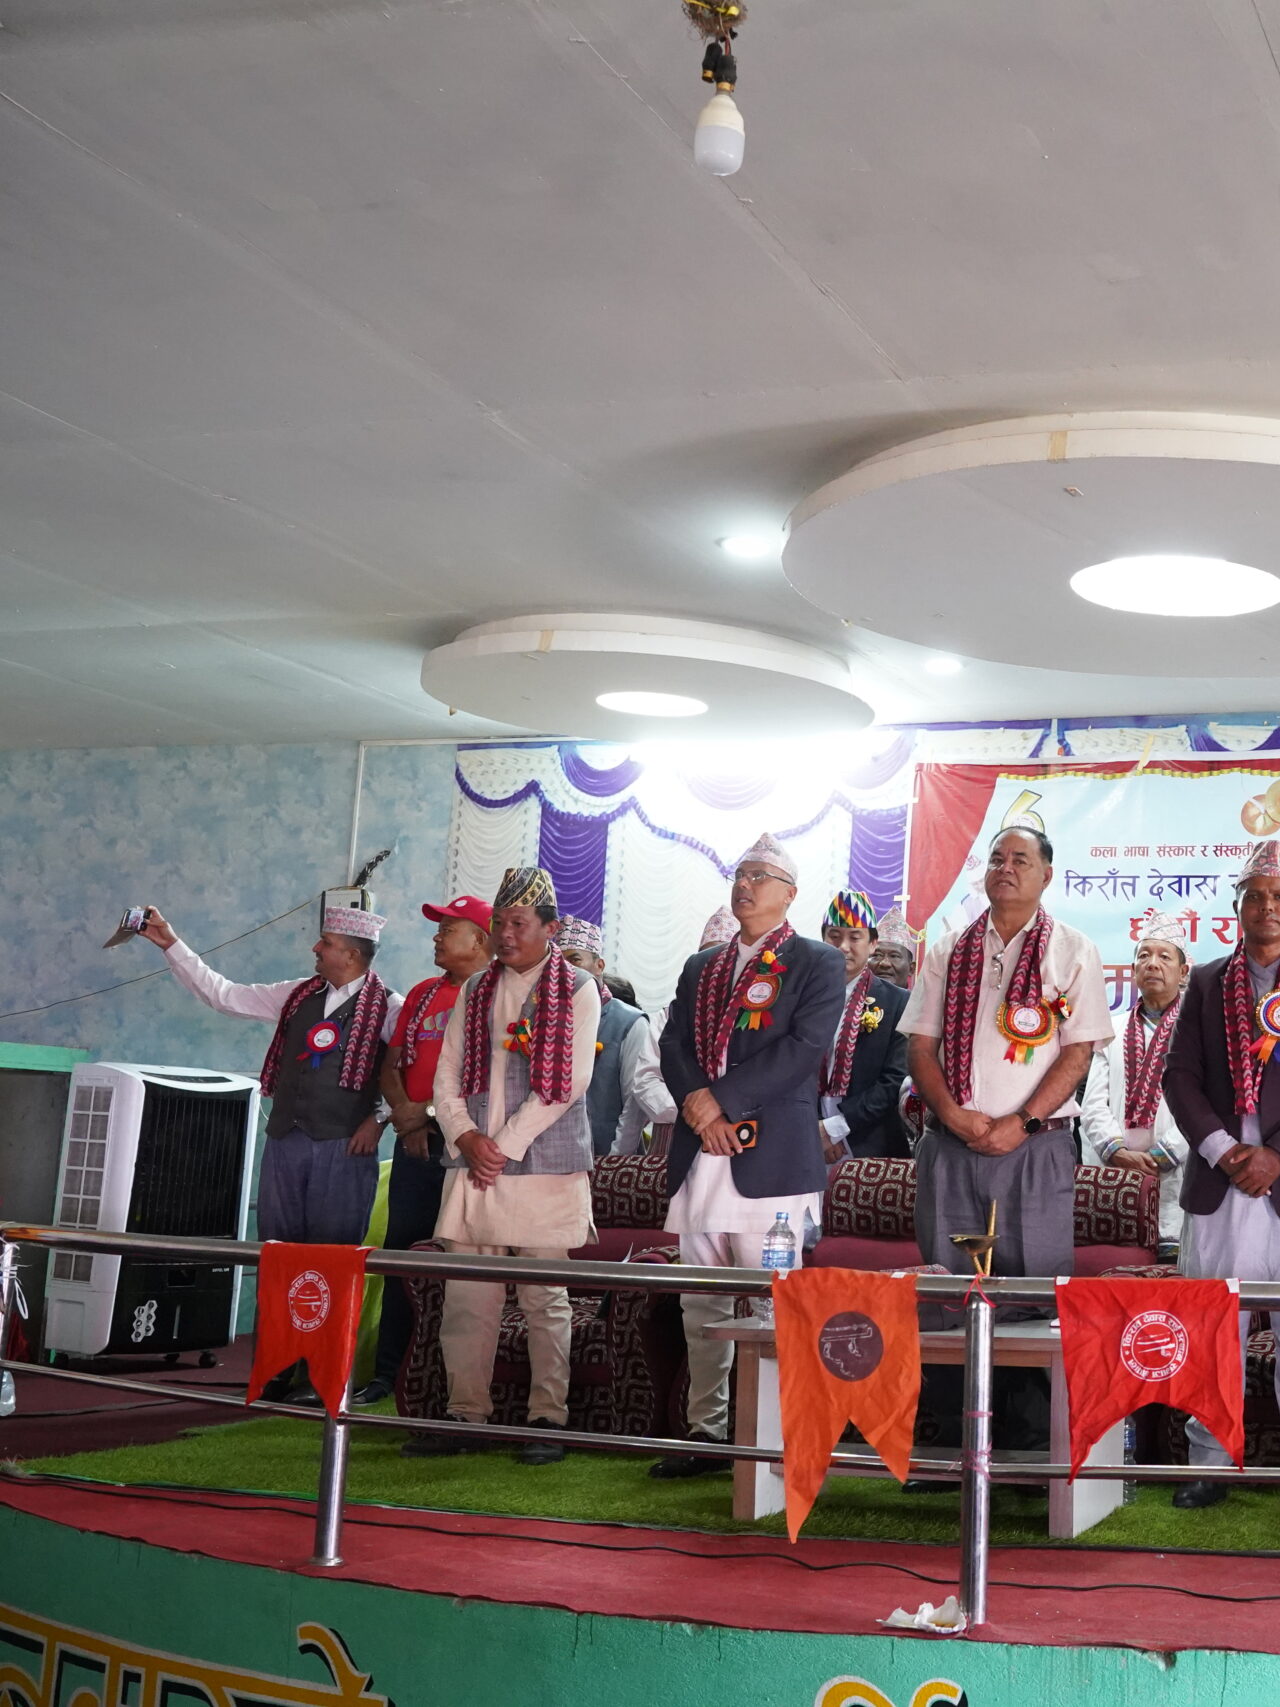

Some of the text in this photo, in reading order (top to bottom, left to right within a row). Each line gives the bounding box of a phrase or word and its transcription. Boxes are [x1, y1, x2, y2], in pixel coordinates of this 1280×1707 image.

[1156, 843, 1197, 858] संस्कार
[1200, 845, 1209, 857] र
[1147, 868, 1220, 901] देवास
